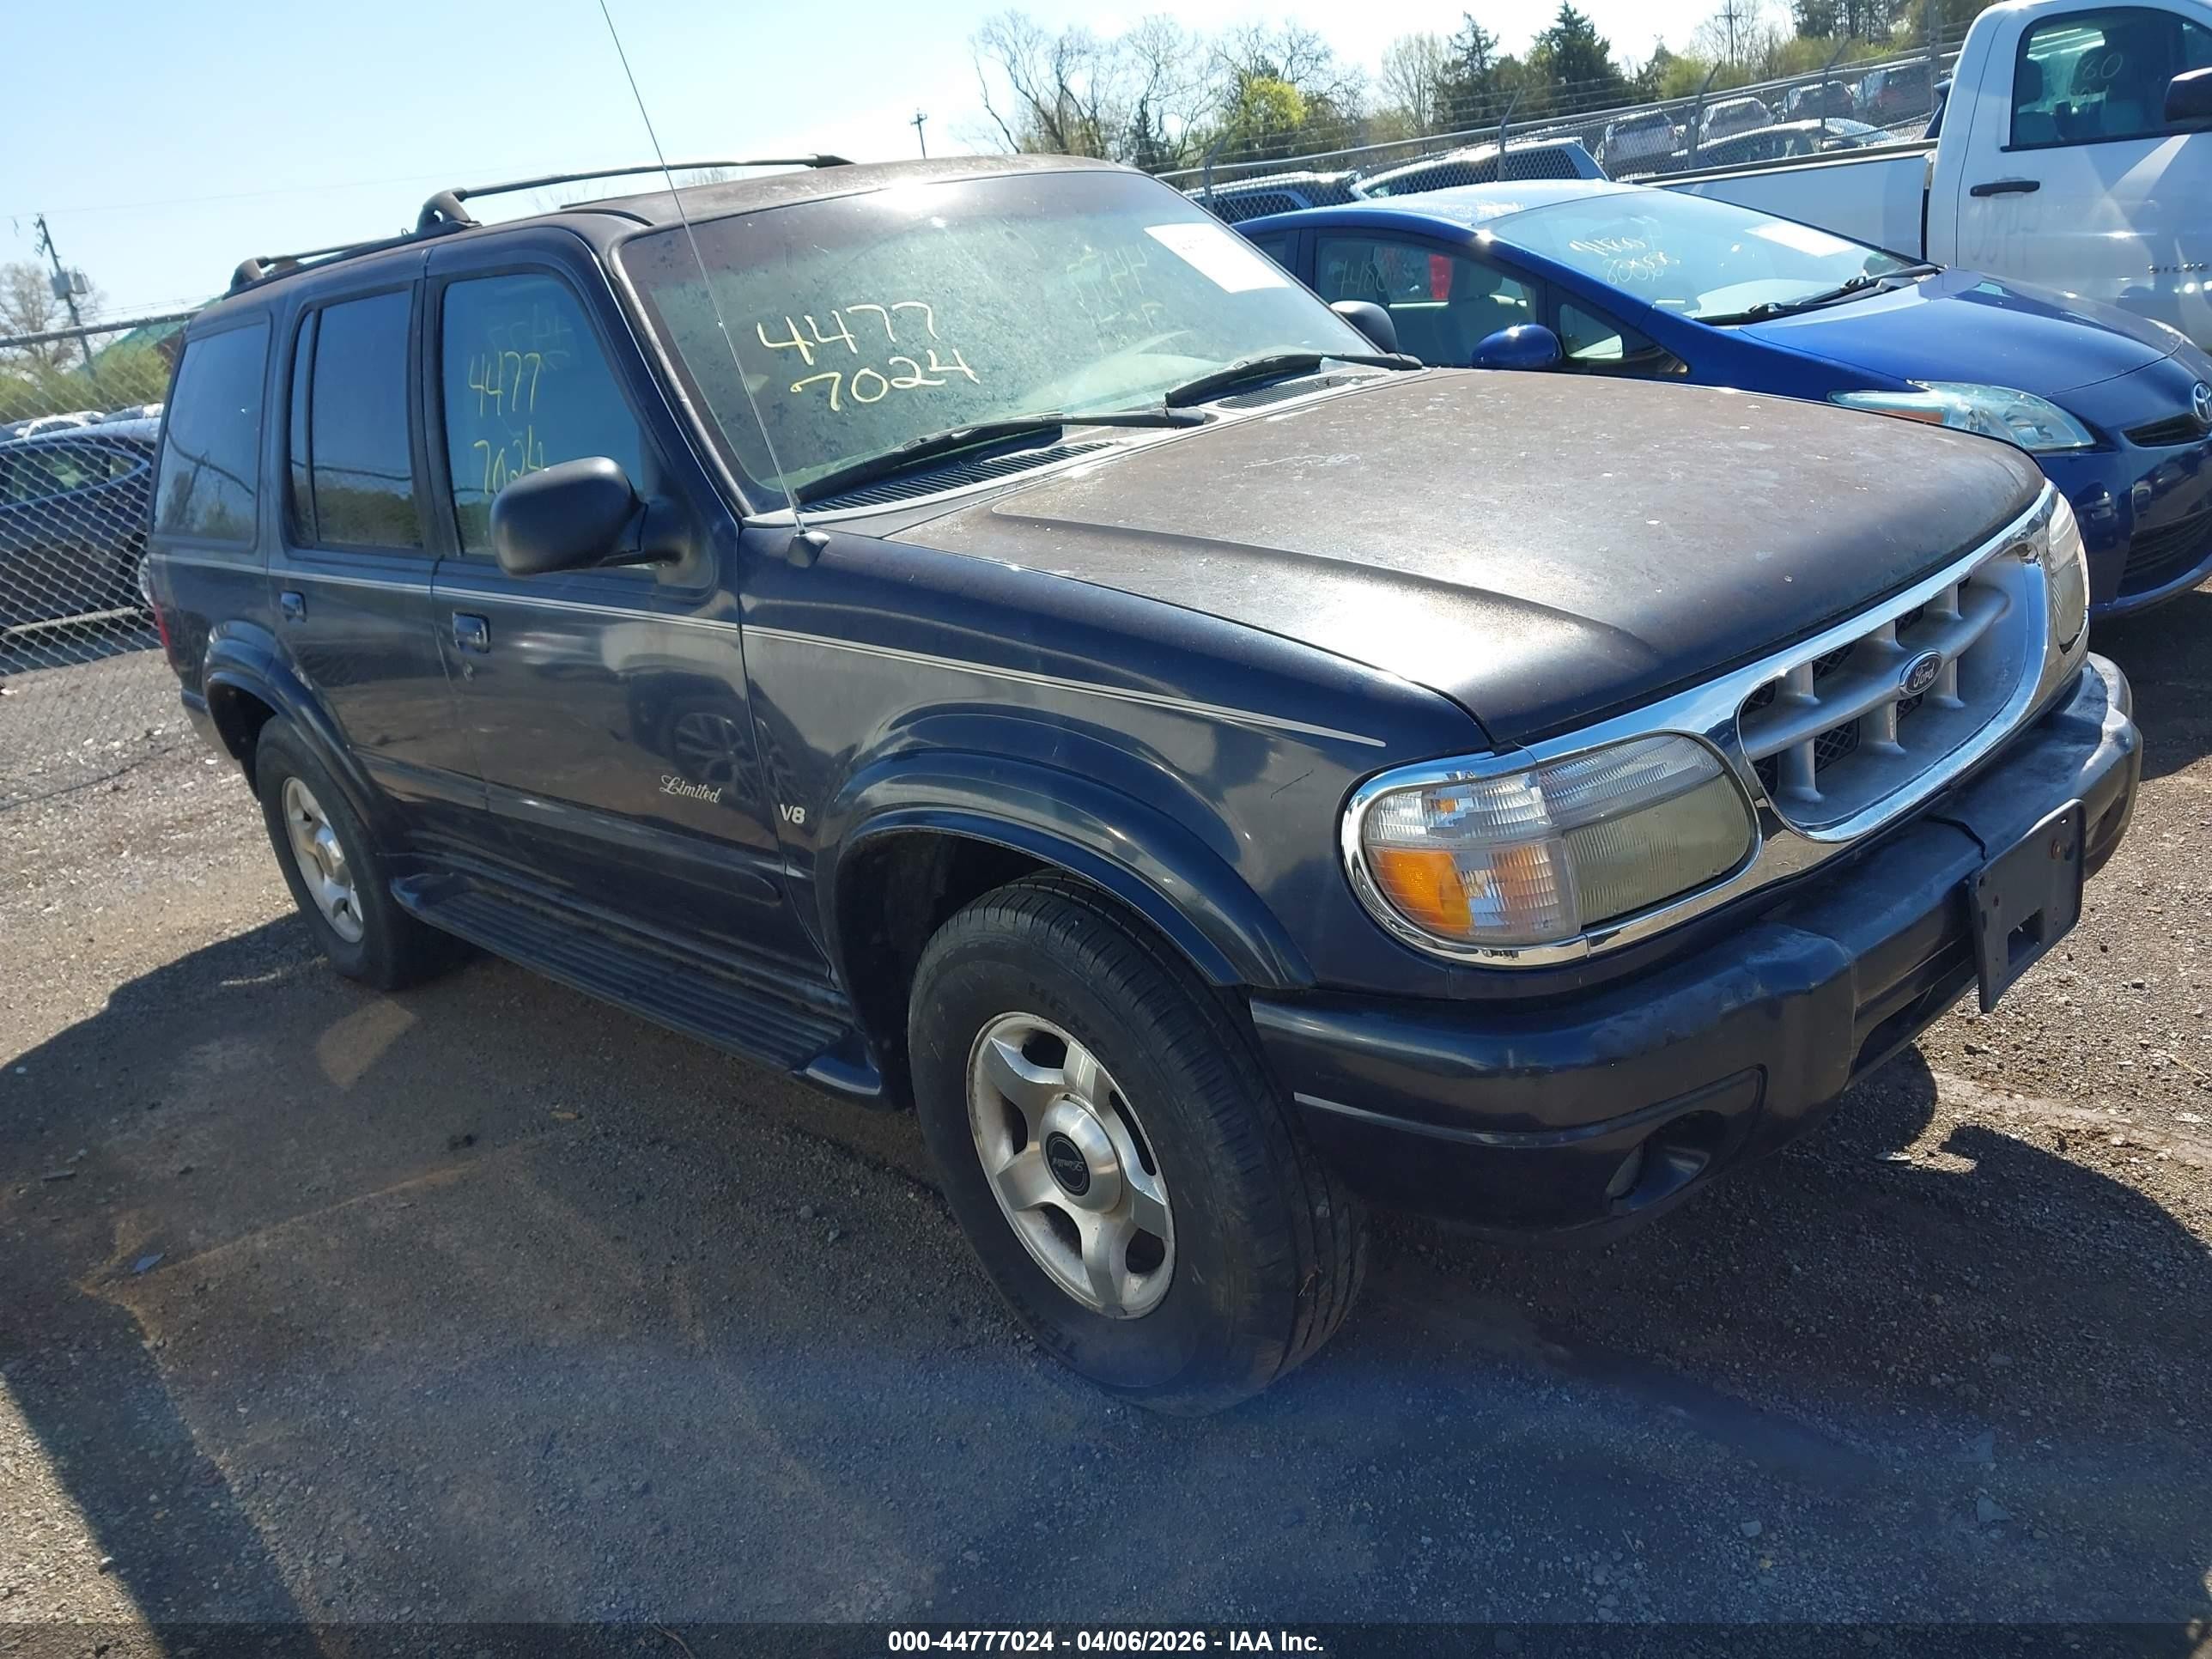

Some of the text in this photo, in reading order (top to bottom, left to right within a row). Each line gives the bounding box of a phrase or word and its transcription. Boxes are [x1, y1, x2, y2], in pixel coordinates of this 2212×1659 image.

[757, 301, 939, 367] 4477
[468, 349, 541, 417] 4477
[790, 348, 980, 411] 7024
[473, 424, 544, 495] 7024
[659, 775, 722, 804] Limited
[779, 803, 805, 824] V8
